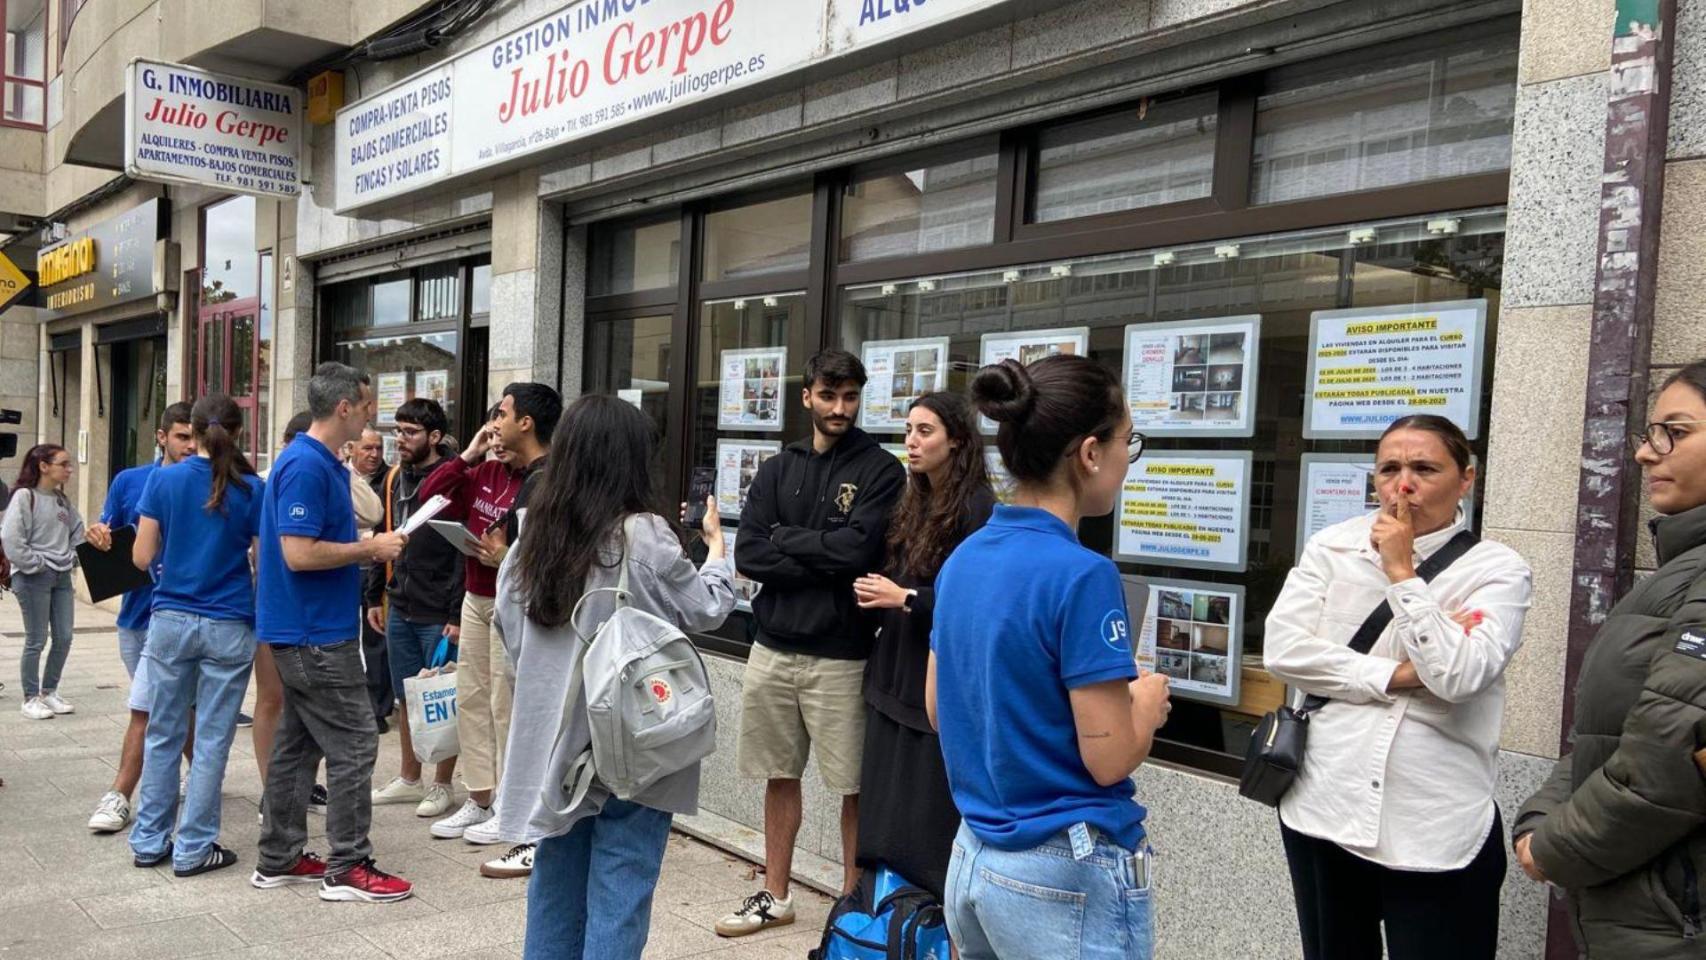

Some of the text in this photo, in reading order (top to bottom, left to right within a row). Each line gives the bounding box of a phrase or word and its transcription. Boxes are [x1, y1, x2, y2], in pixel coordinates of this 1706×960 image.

[860, 0, 926, 26] ALQ
[492, 0, 650, 69] GESTION INMO
[499, 0, 735, 124] Julio Gerpe
[143, 69, 292, 114] G. INMOBILIARIA
[632, 54, 766, 110] www.juliogerpe.es
[145, 97, 289, 146] Julio Gerpe
[350, 77, 451, 137] COMPRA-VENTA PISOS
[580, 113, 593, 128] 981
[595, 107, 609, 124] 591
[610, 102, 626, 118] 585
[141, 133, 196, 151] ALQUILERES
[204, 143, 239, 159] COMPRA
[240, 150, 267, 164] VENTA
[269, 154, 293, 168] PISOS
[351, 112, 447, 166] BAJOS COMERCIALES
[138, 147, 297, 182] APARTAMENTOS-BAJOS COMERCIALES
[355, 149, 440, 194] FINCAS Y SOLARES
[236, 176, 254, 186] 981
[258, 180, 275, 191] 591
[279, 184, 296, 193] 585
[1345, 320, 1437, 335] AVISO IMPORTANTE
[1370, 388, 1415, 397] PUBLICADAS
[1168, 467, 1215, 477] IMPORTANTE
[424, 700, 449, 724] EN
